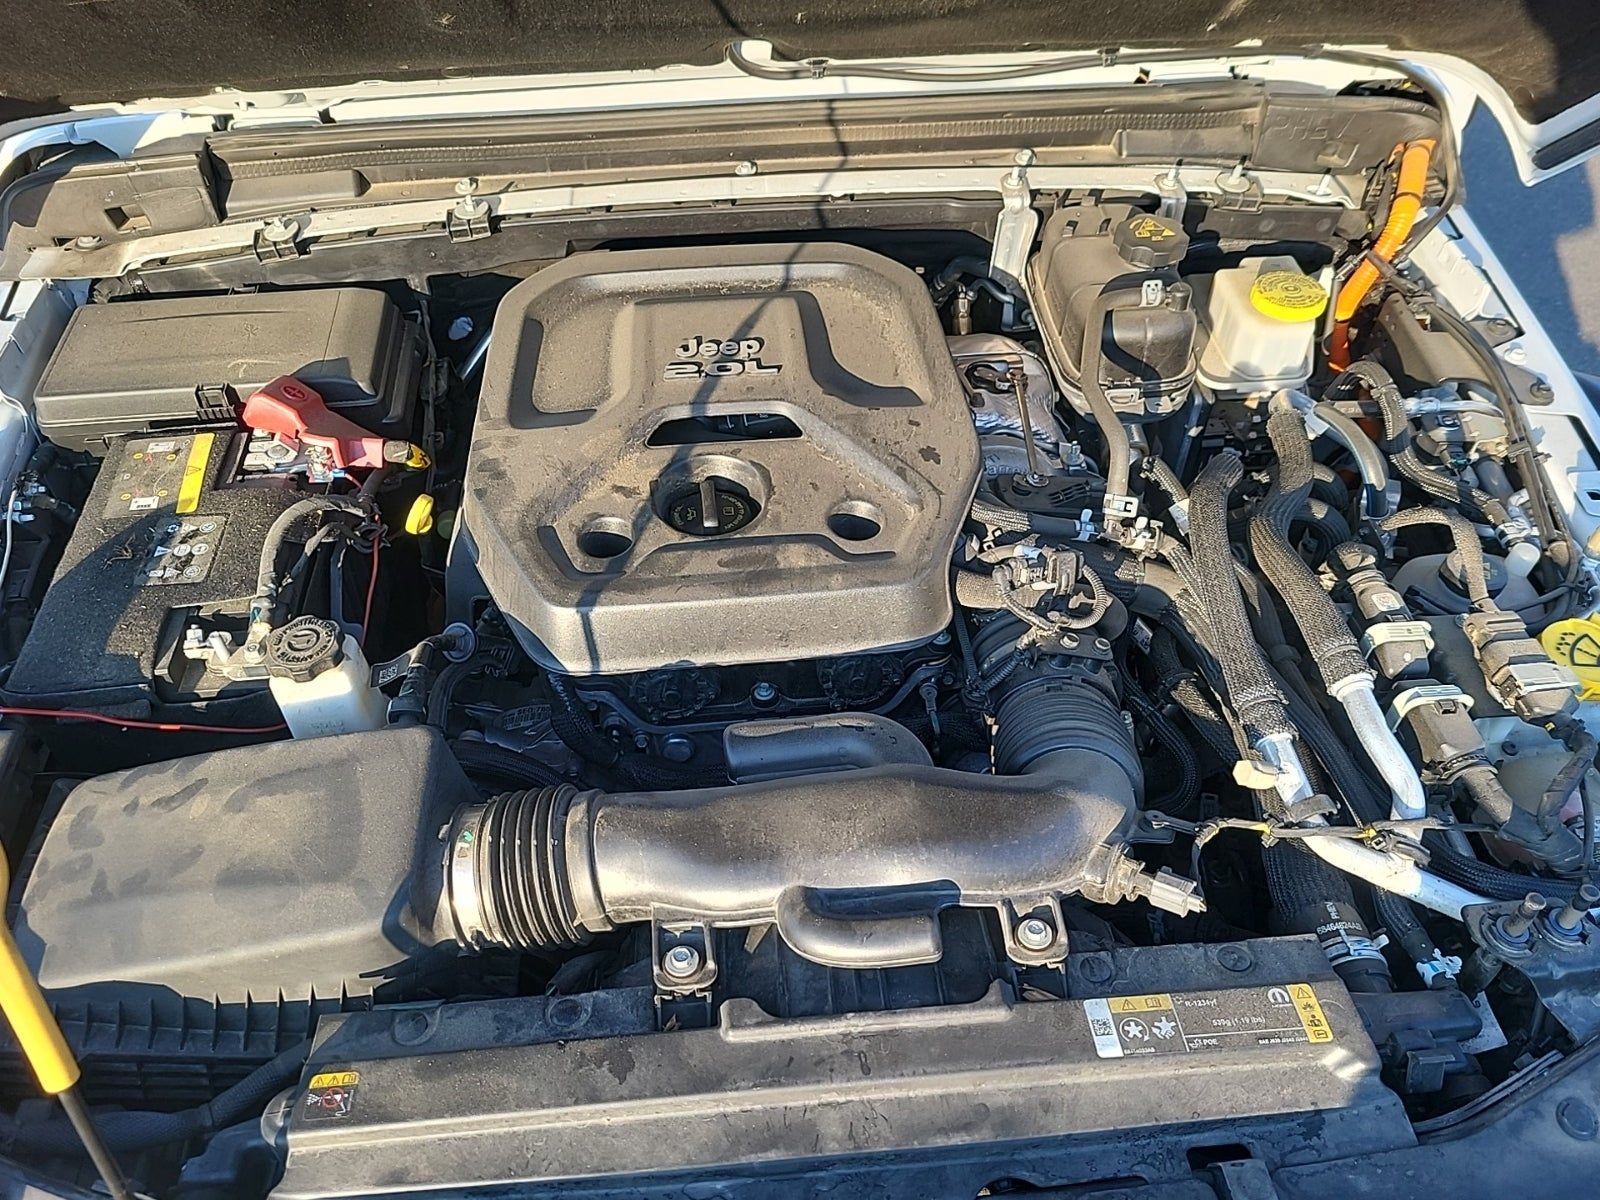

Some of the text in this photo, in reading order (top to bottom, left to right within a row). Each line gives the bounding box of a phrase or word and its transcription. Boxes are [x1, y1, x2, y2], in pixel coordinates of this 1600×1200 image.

[674, 336, 764, 360] Jeep
[664, 358, 783, 381] 2.0L
[1324, 901, 1340, 920] PHEV
